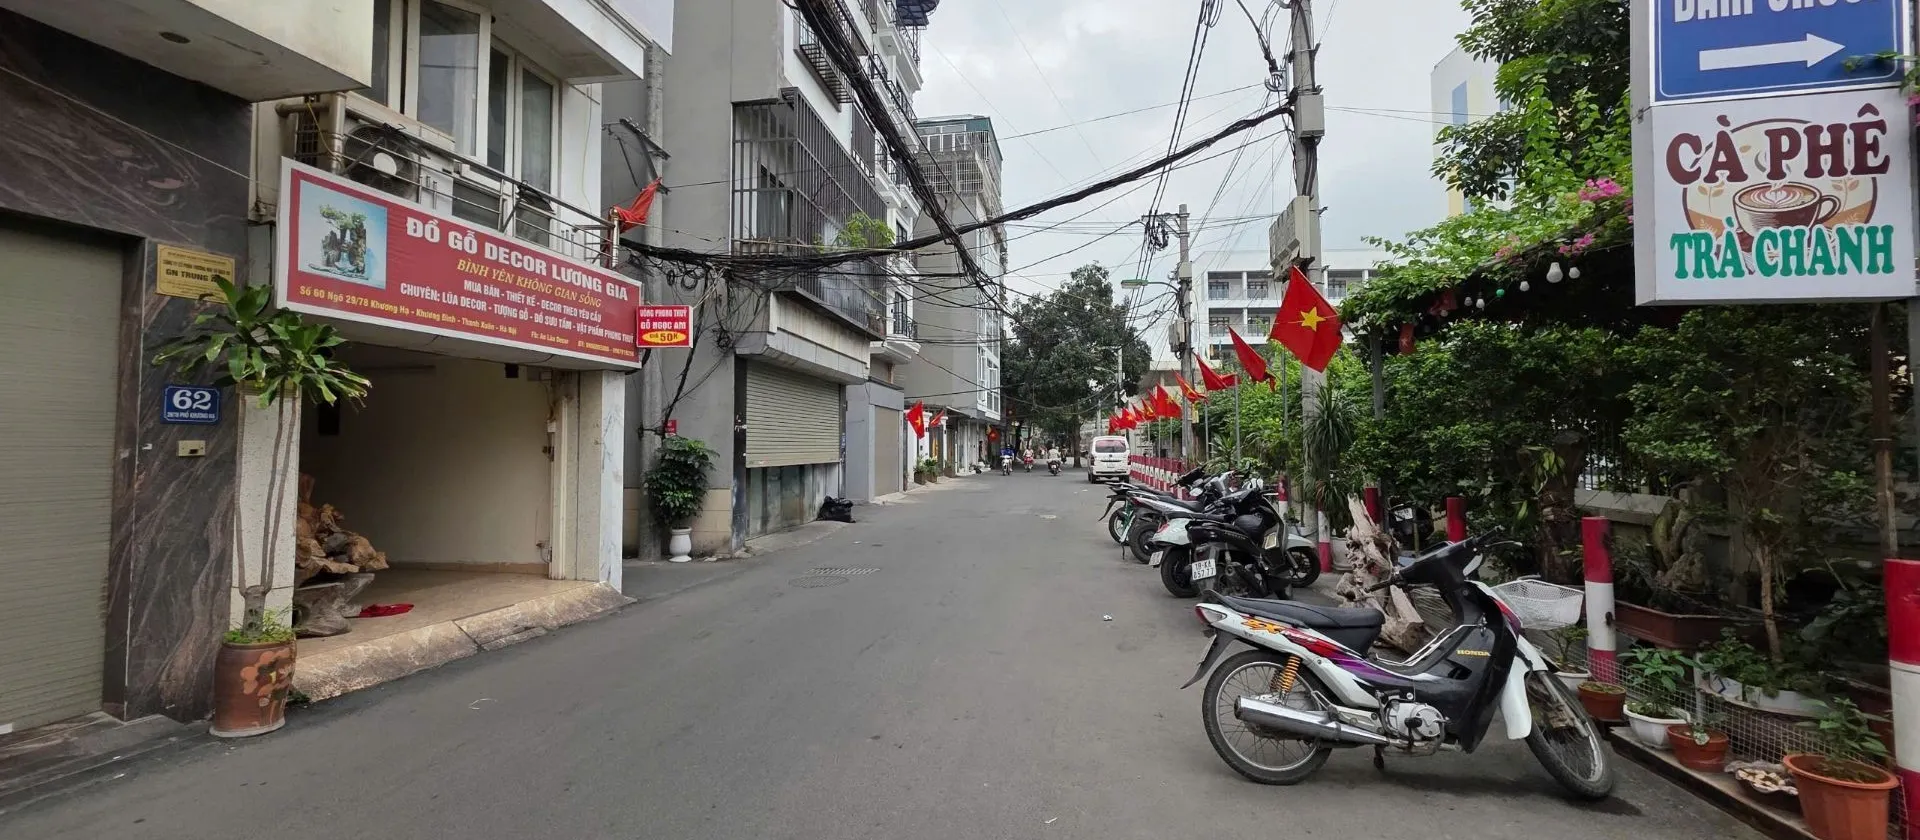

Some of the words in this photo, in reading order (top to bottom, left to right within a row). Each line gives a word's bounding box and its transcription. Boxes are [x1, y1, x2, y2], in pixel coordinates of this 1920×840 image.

[1666, 114, 1748, 185] CÀ
[1765, 103, 1890, 180] PHÊ
[406, 216, 440, 243] ĐỒ
[448, 230, 478, 254] GỖ
[484, 242, 547, 276] DECOR
[552, 264, 602, 293] LƯƠNG
[605, 282, 628, 301] GIA
[1669, 216, 1745, 279] TRÀ
[1755, 224, 1895, 277] CHANH
[300, 285, 312, 296] Số
[313, 288, 325, 299] 60
[346, 295, 369, 307] 29/78
[400, 282, 440, 302] CHUYÊN:
[460, 296, 487, 312] DECOR
[457, 258, 489, 277] BÌNH
[492, 268, 515, 284] YÊN
[516, 275, 553, 294] KHÔNG
[554, 286, 578, 301] GIAN
[578, 291, 602, 308] SỐNG
[464, 280, 482, 294] MUA
[484, 284, 500, 298] BÁN
[541, 299, 561, 313] DECOR
[562, 305, 578, 317] THEO
[173, 389, 212, 410] 62
[1456, 649, 1492, 657] HONDA
